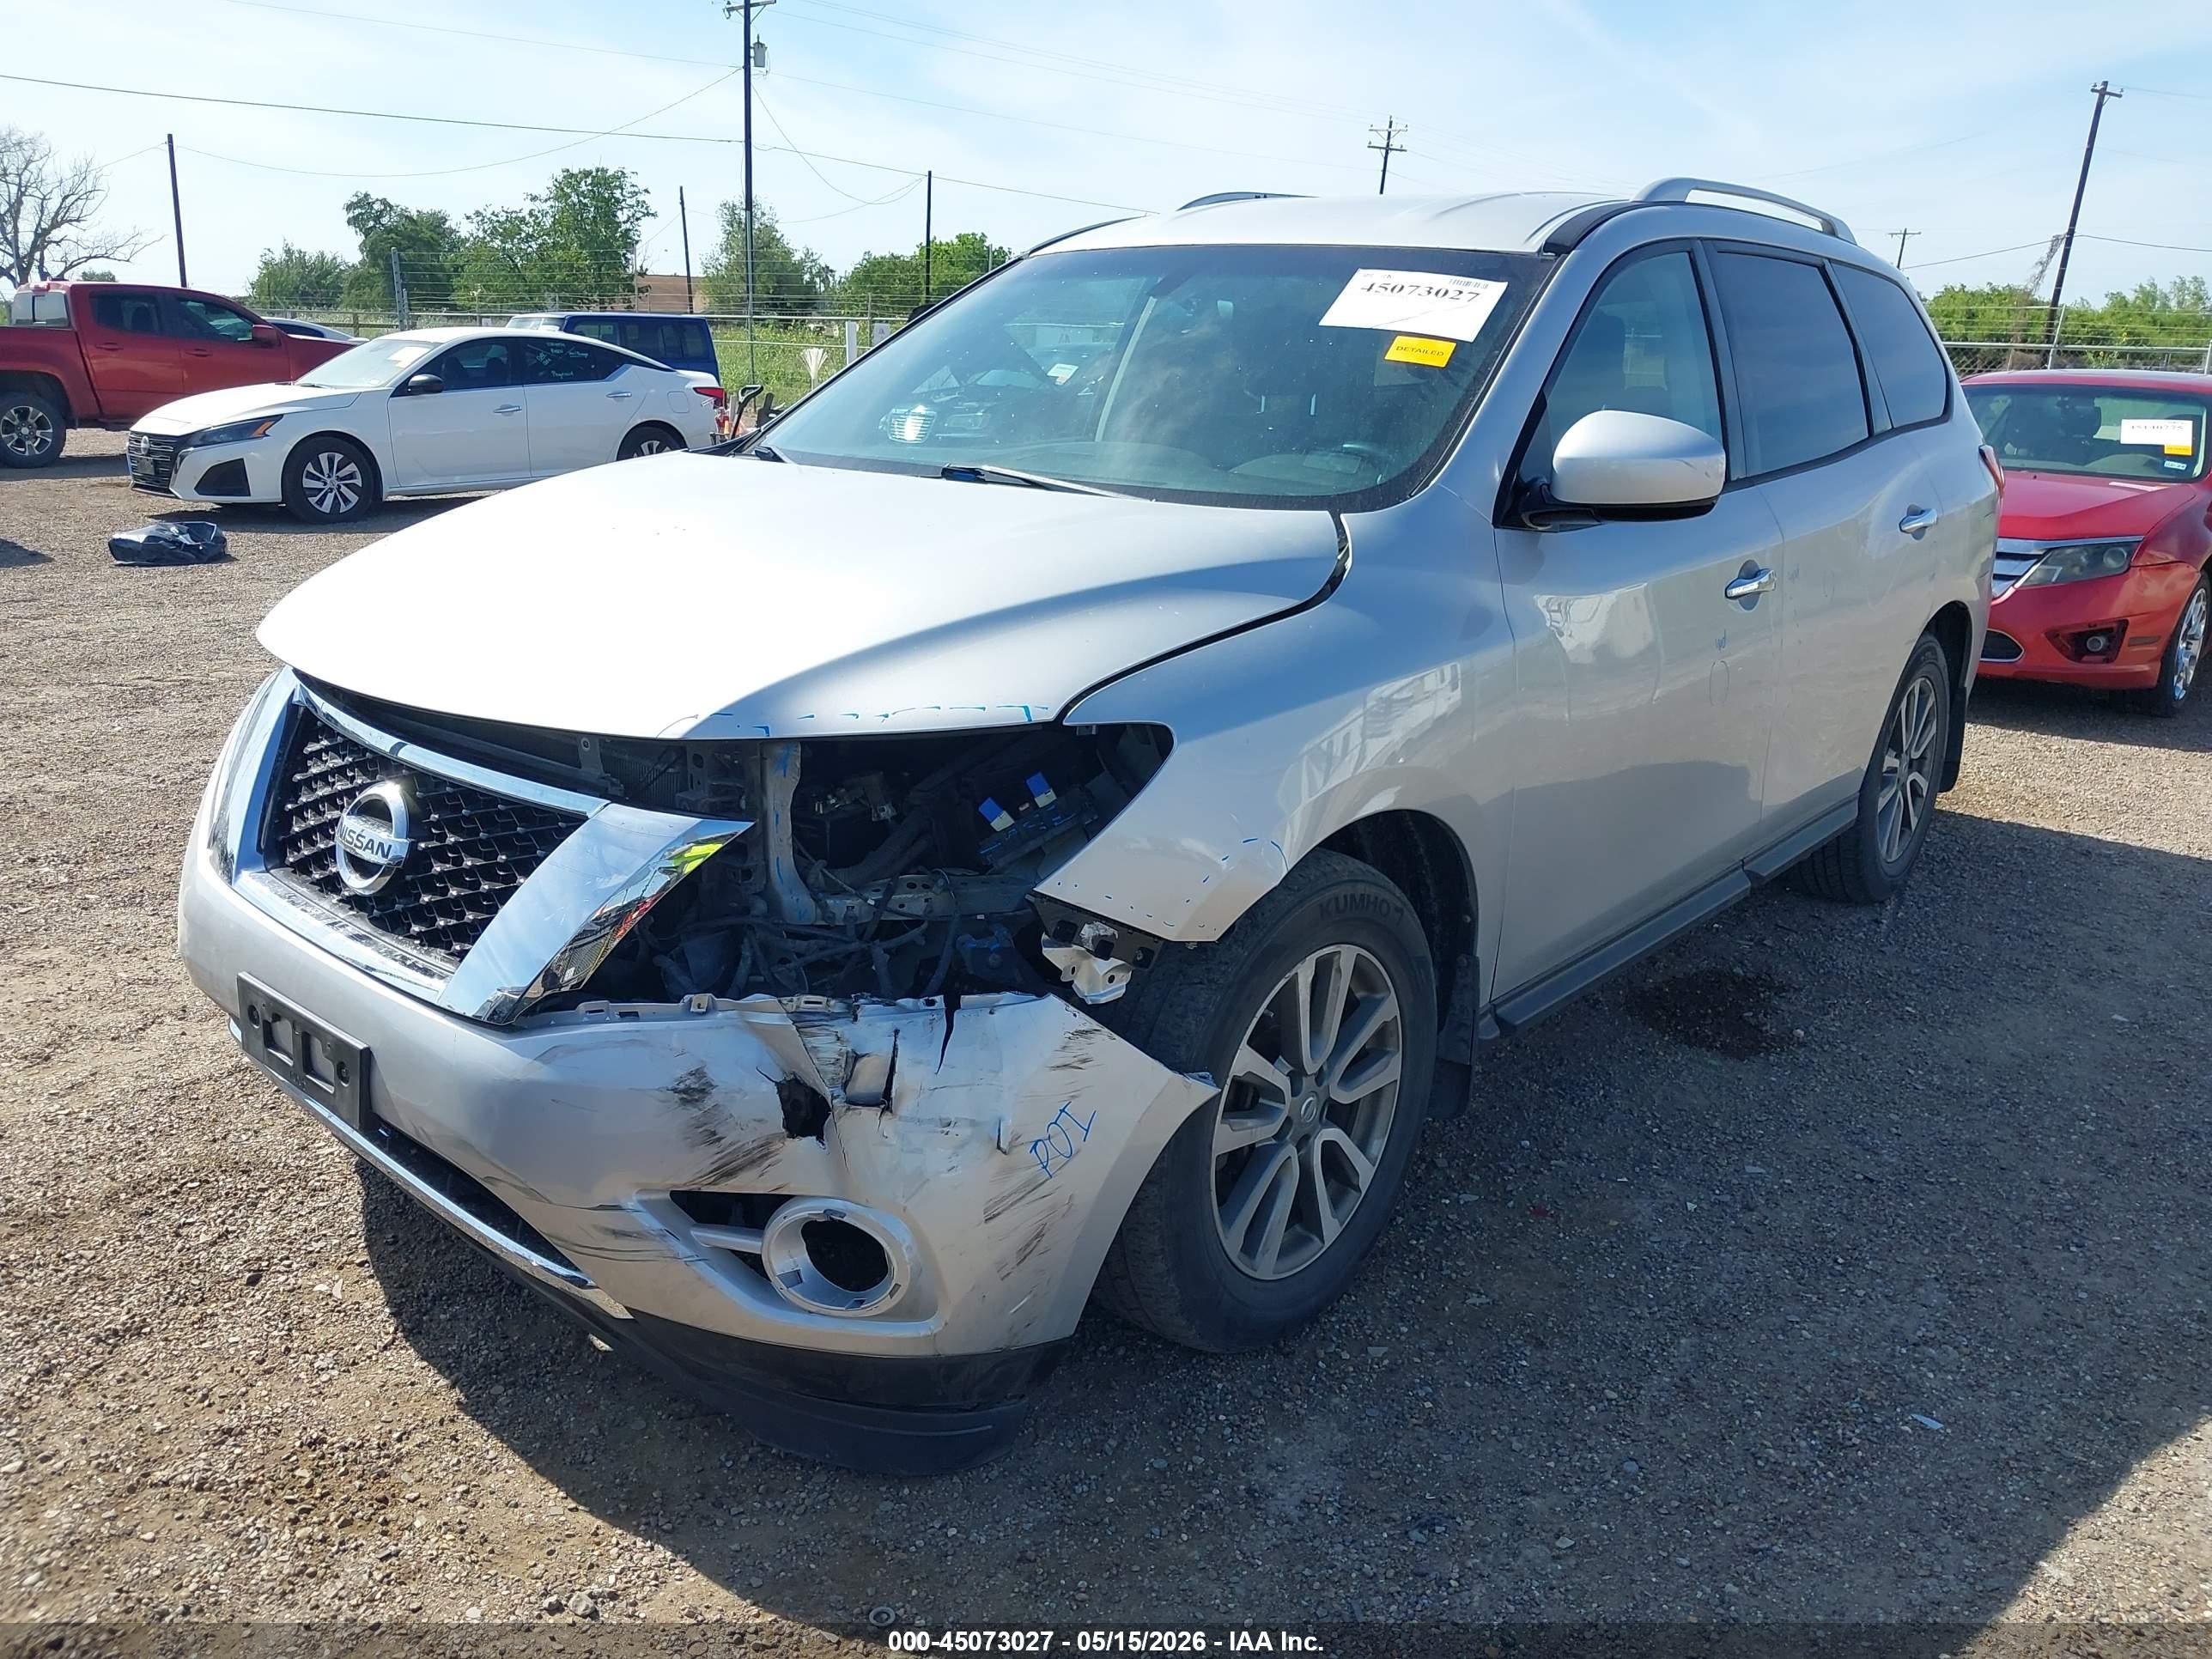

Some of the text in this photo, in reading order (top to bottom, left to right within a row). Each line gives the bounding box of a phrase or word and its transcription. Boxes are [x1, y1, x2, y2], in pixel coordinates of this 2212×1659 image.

[1360, 282, 1481, 302] 45073027
[1395, 345, 1445, 357] DETAILED
[337, 823, 393, 860] NISSAN
[1319, 892, 1391, 921] KUMHO
[1030, 1101, 1097, 1179] POI
